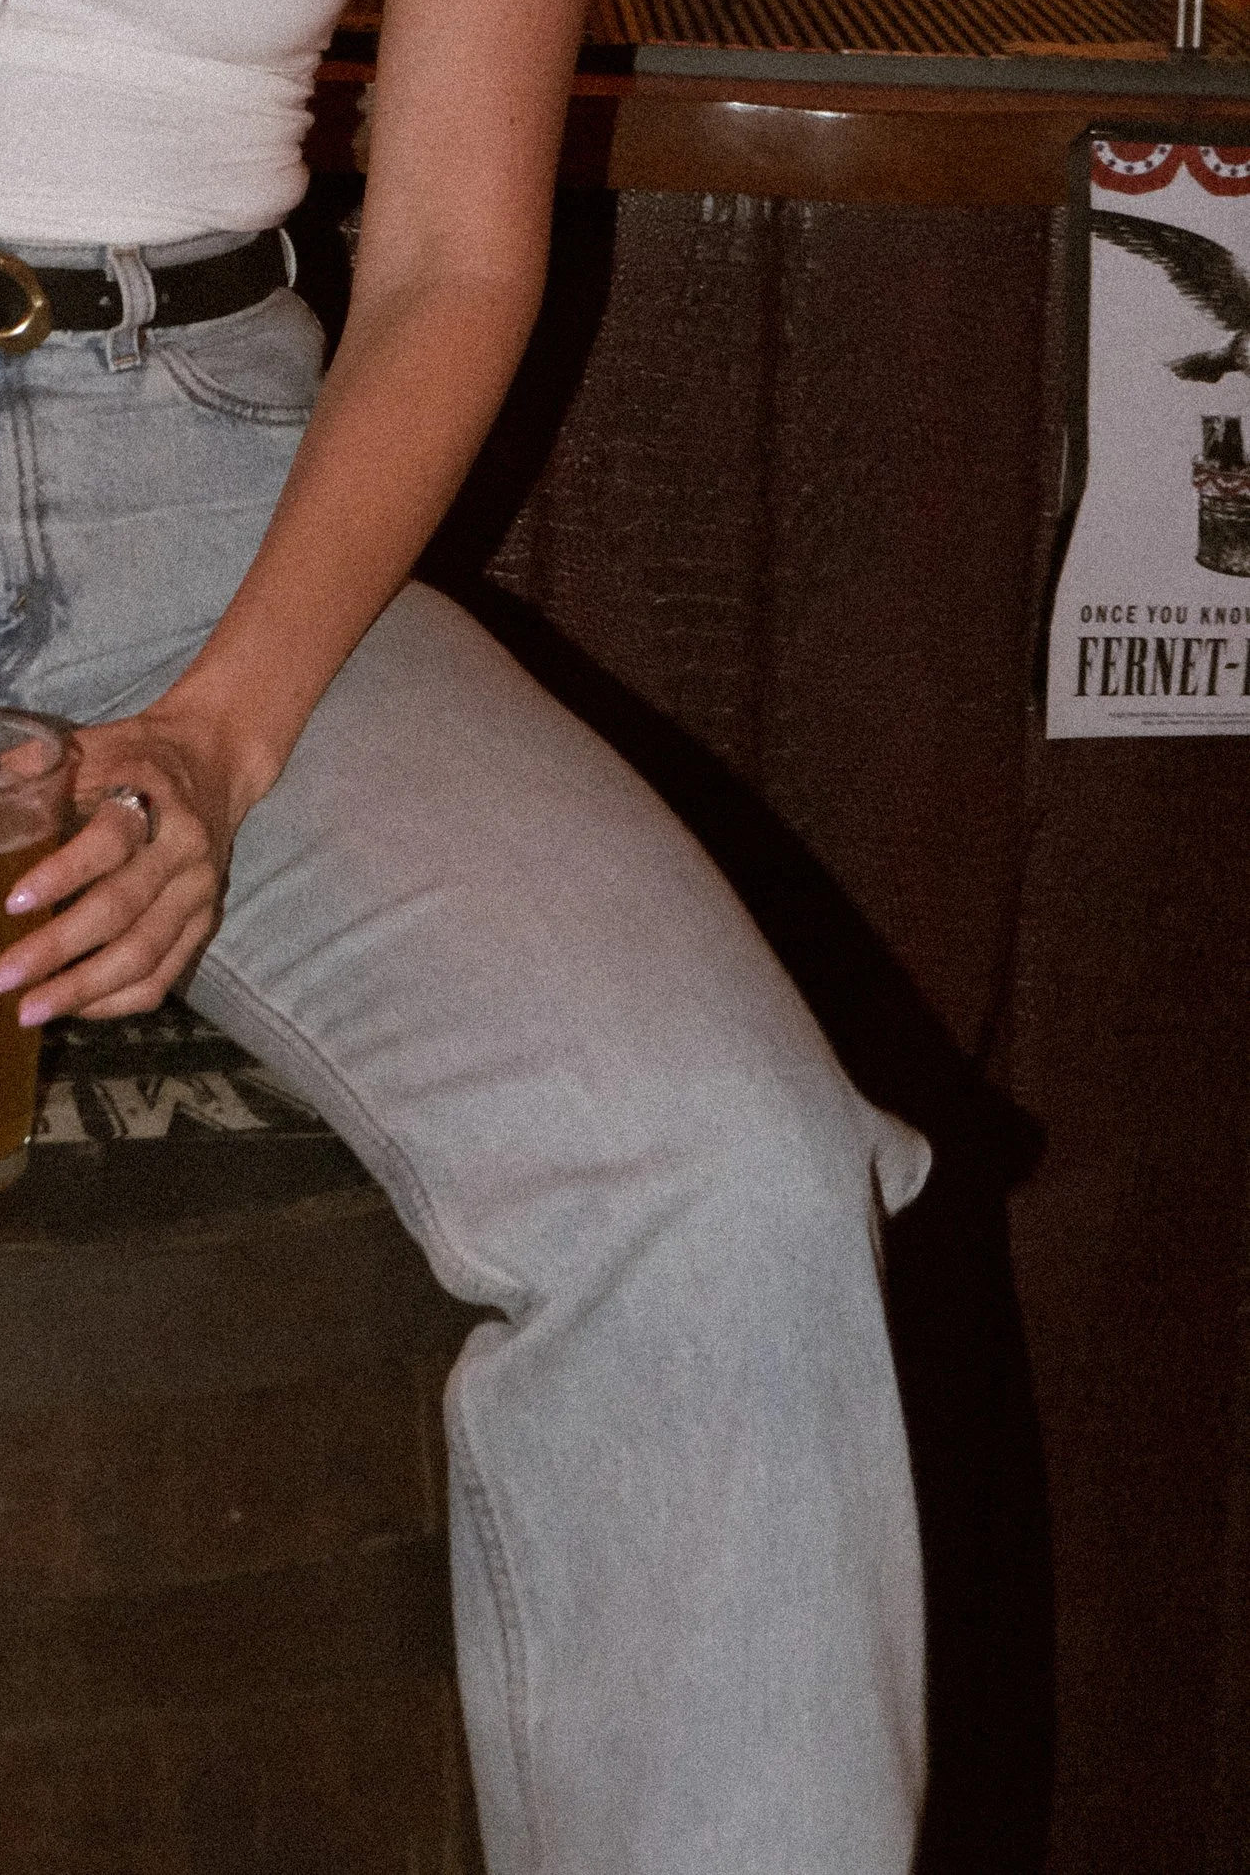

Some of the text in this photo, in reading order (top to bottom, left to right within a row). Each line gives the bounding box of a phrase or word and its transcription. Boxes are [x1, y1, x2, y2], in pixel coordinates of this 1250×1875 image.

[1080, 605, 1250, 625] ONCE YOU KNO
